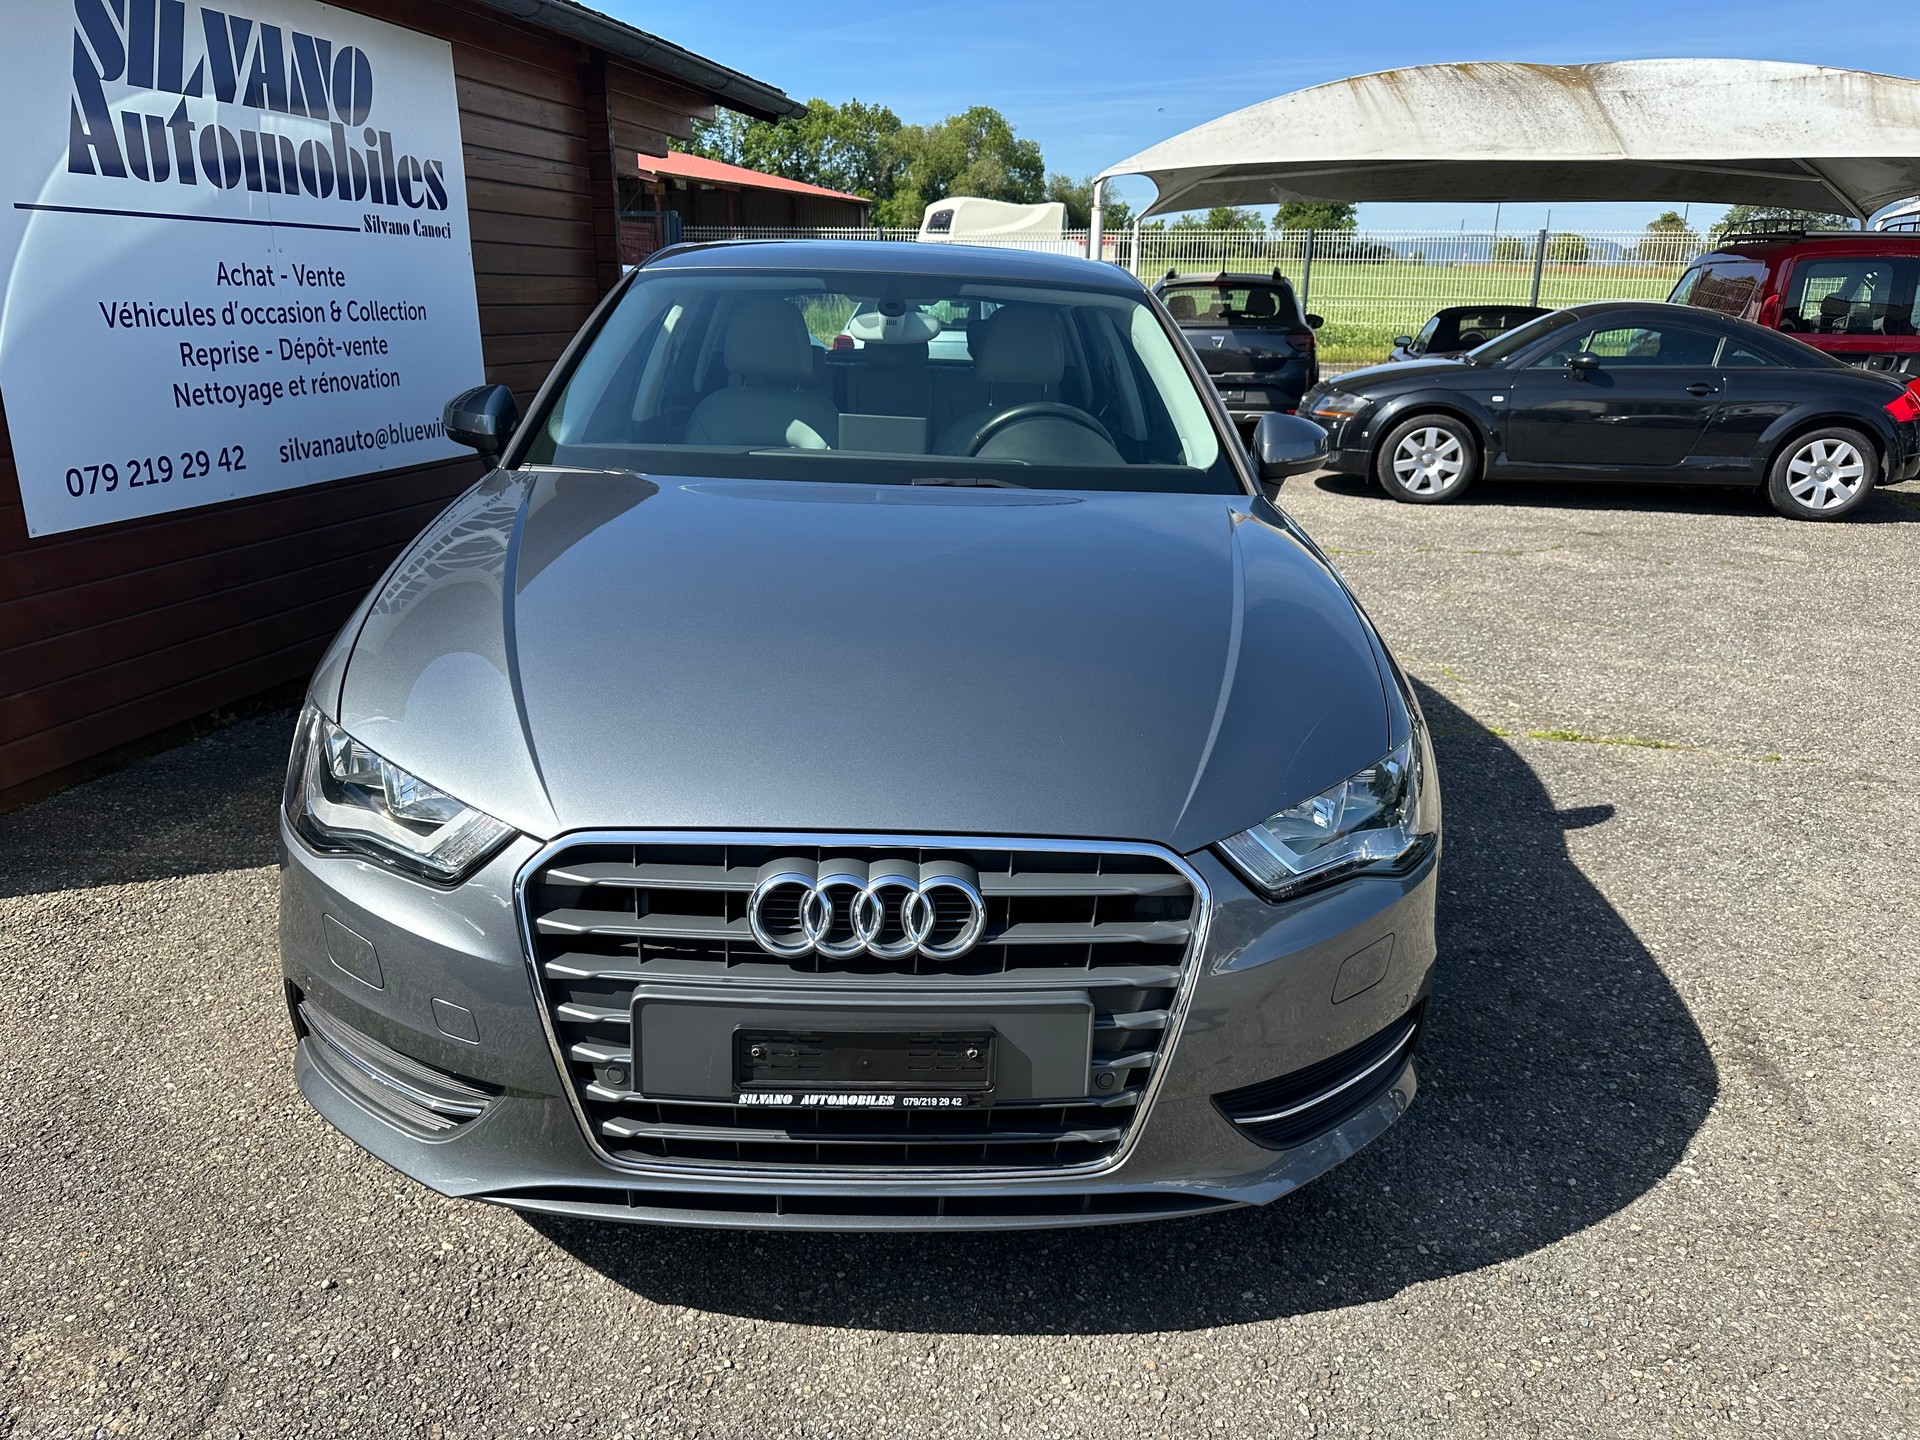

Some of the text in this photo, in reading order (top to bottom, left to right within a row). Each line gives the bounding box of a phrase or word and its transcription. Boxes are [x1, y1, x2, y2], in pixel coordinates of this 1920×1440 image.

[73, 0, 373, 127] SILVANO
[68, 72, 448, 211] Automobiles
[363, 214, 451, 239] Silvano Canoci
[216, 261, 275, 287] Achat
[292, 263, 346, 287] Vente
[99, 301, 217, 328] Véhicules
[330, 301, 343, 322] &
[347, 301, 427, 322] Collection
[179, 340, 260, 371] Reprise
[279, 336, 389, 365] Dépôt-vente
[172, 369, 401, 409] Nettoyage et rénovation
[65, 445, 247, 498] 079 219 29 42
[738, 1094, 962, 1107] SILVANO AUTOMOBILES 079/219 29 42
